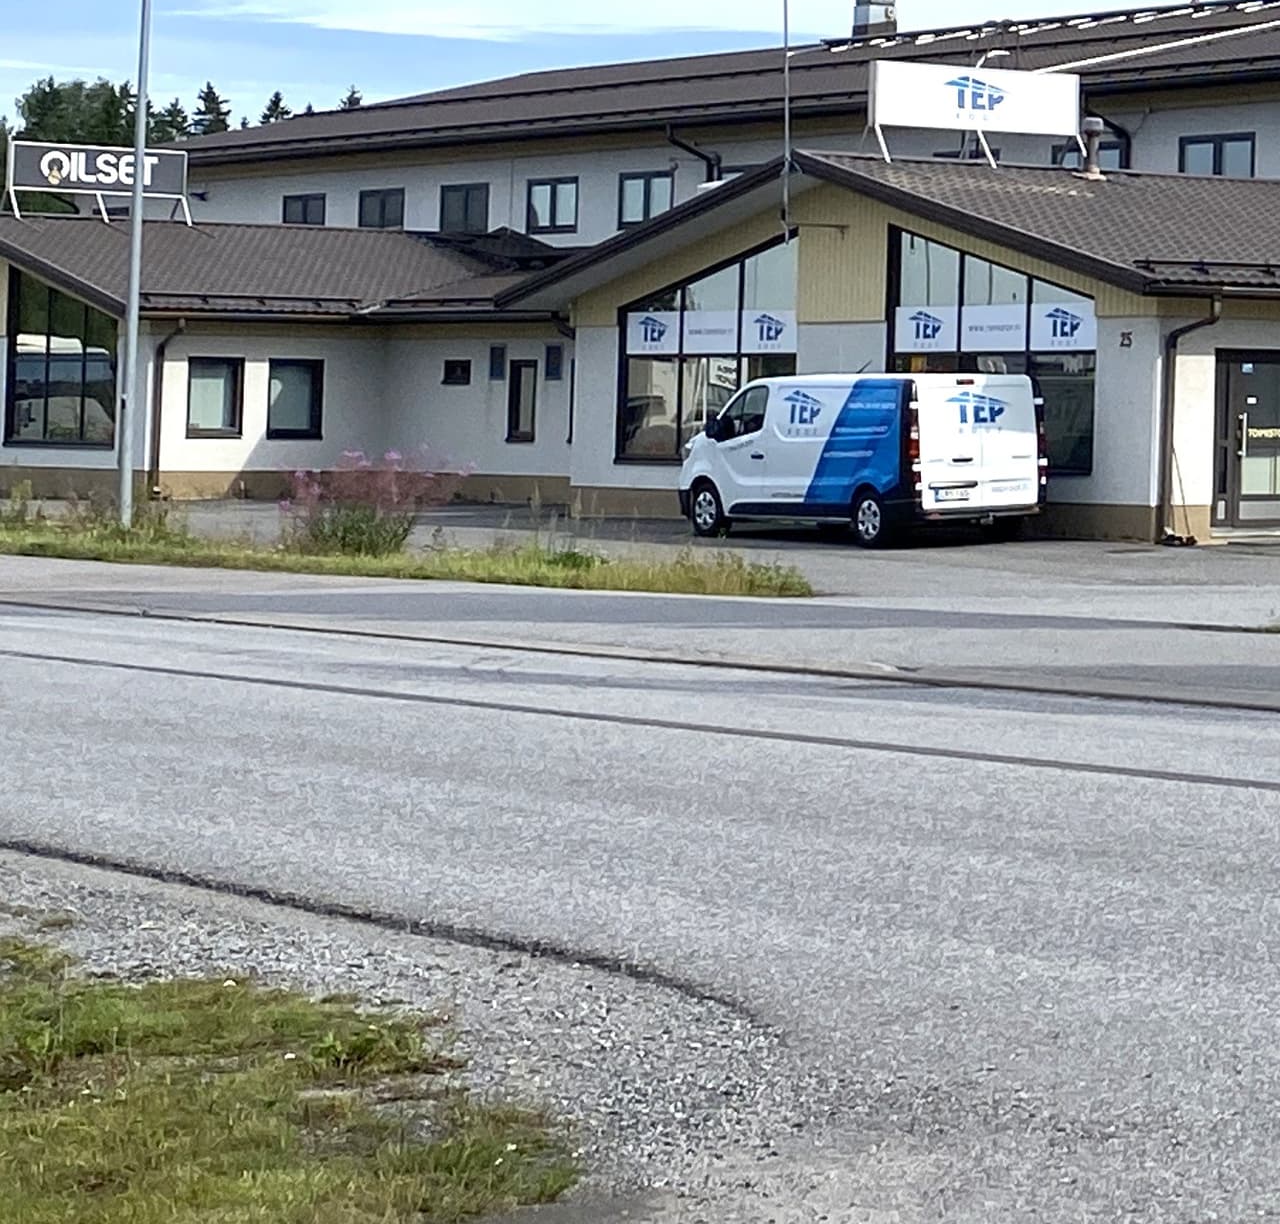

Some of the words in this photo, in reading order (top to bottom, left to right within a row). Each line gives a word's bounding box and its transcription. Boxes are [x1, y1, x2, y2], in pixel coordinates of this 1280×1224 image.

[950, 80, 1006, 110] TEP
[40, 151, 159, 185] OILSET
[952, 397, 1007, 423] TEP
